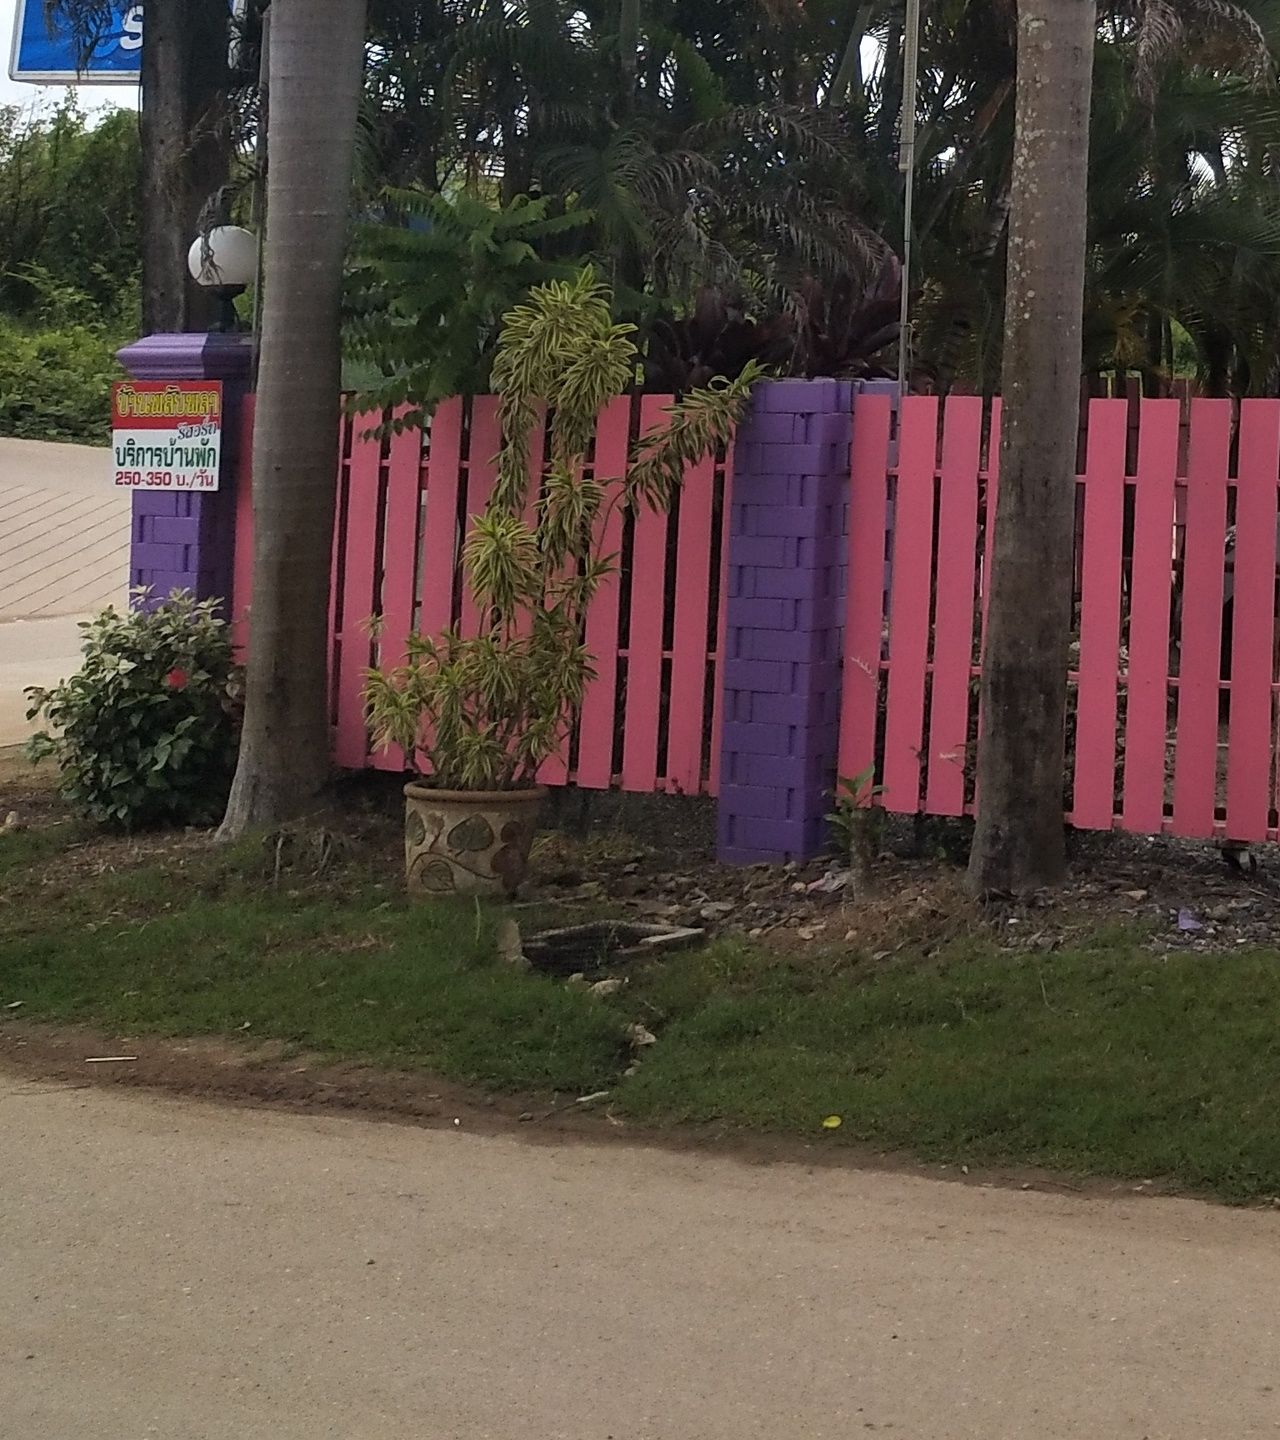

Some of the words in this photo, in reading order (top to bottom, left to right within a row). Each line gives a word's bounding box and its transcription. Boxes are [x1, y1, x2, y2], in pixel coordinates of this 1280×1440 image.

[117, 385, 219, 417] บ้านพลับพลา
[115, 438, 216, 468] บริการบ้านพัก
[115, 471, 171, 486] 250-350
